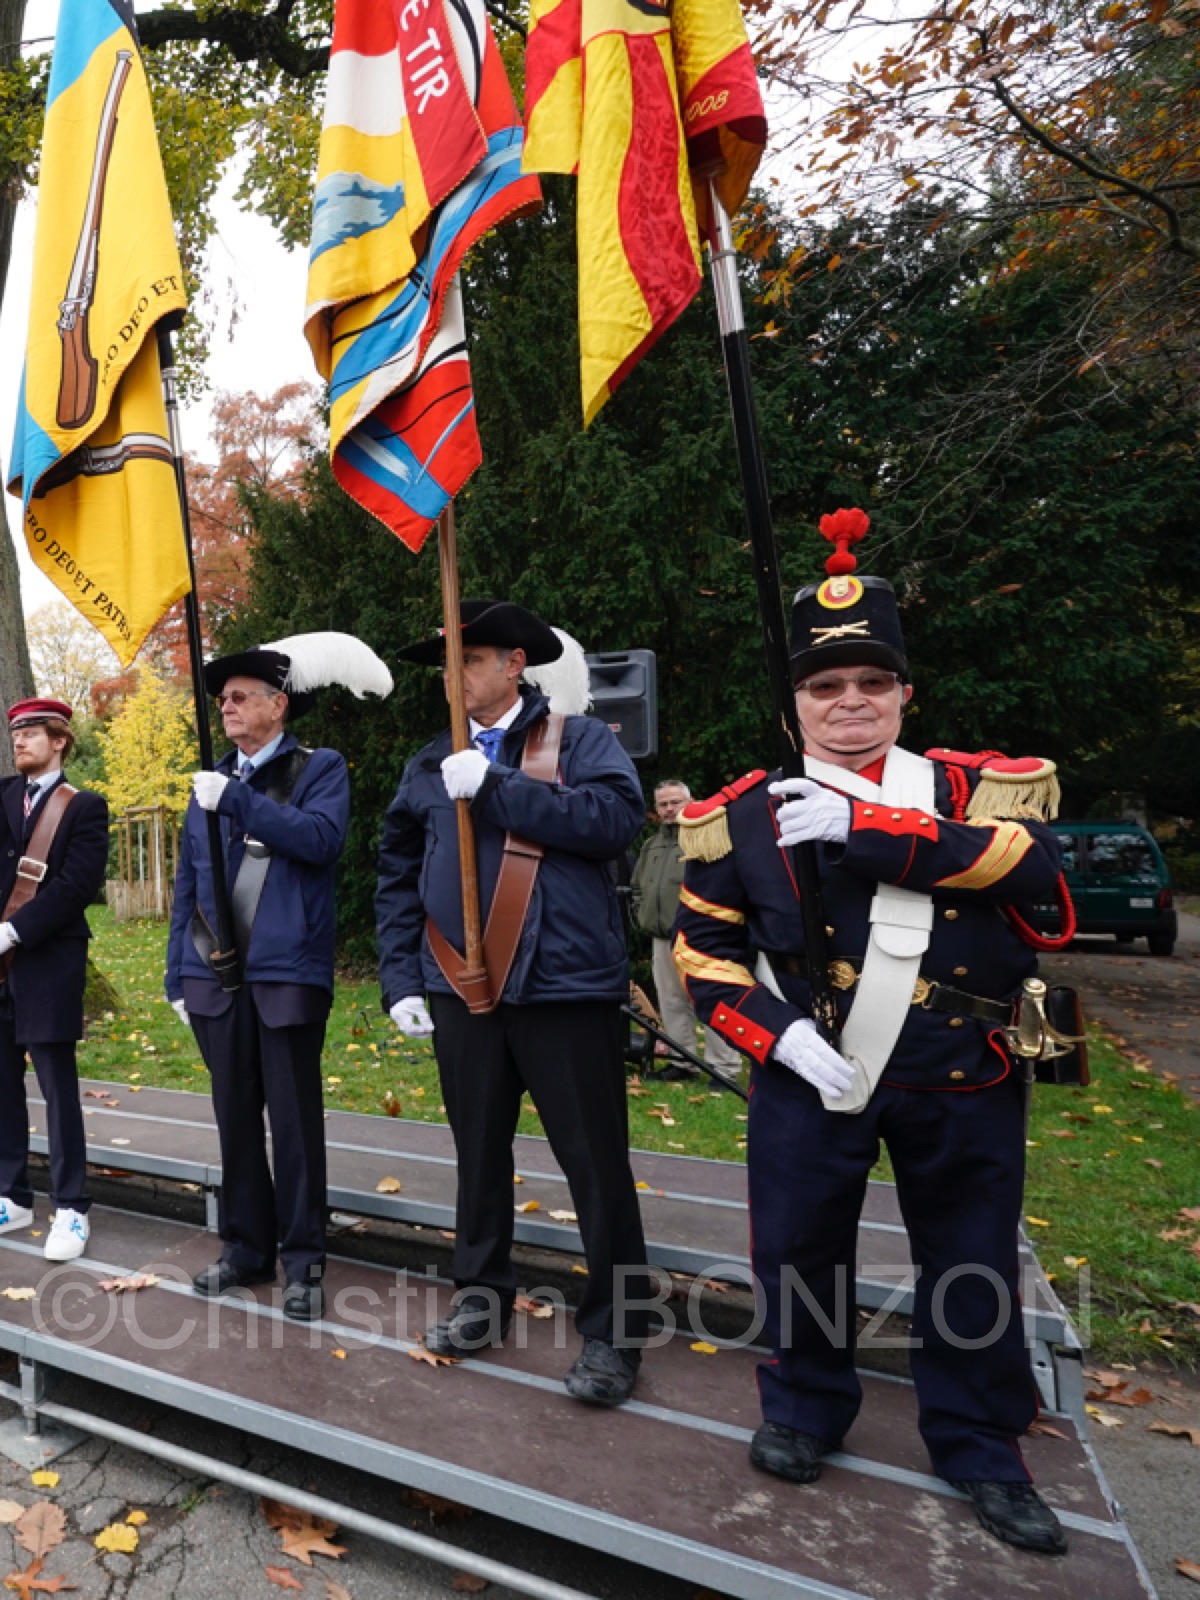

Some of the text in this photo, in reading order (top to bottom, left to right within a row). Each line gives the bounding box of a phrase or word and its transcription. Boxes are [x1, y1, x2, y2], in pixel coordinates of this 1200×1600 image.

[405, 27, 450, 114] TIR
[684, 89, 730, 124] 008
[118, 296, 149, 342] DEO
[150, 275, 179, 297] ET
[45, 539, 77, 576] DEO
[73, 569, 96, 595] ET
